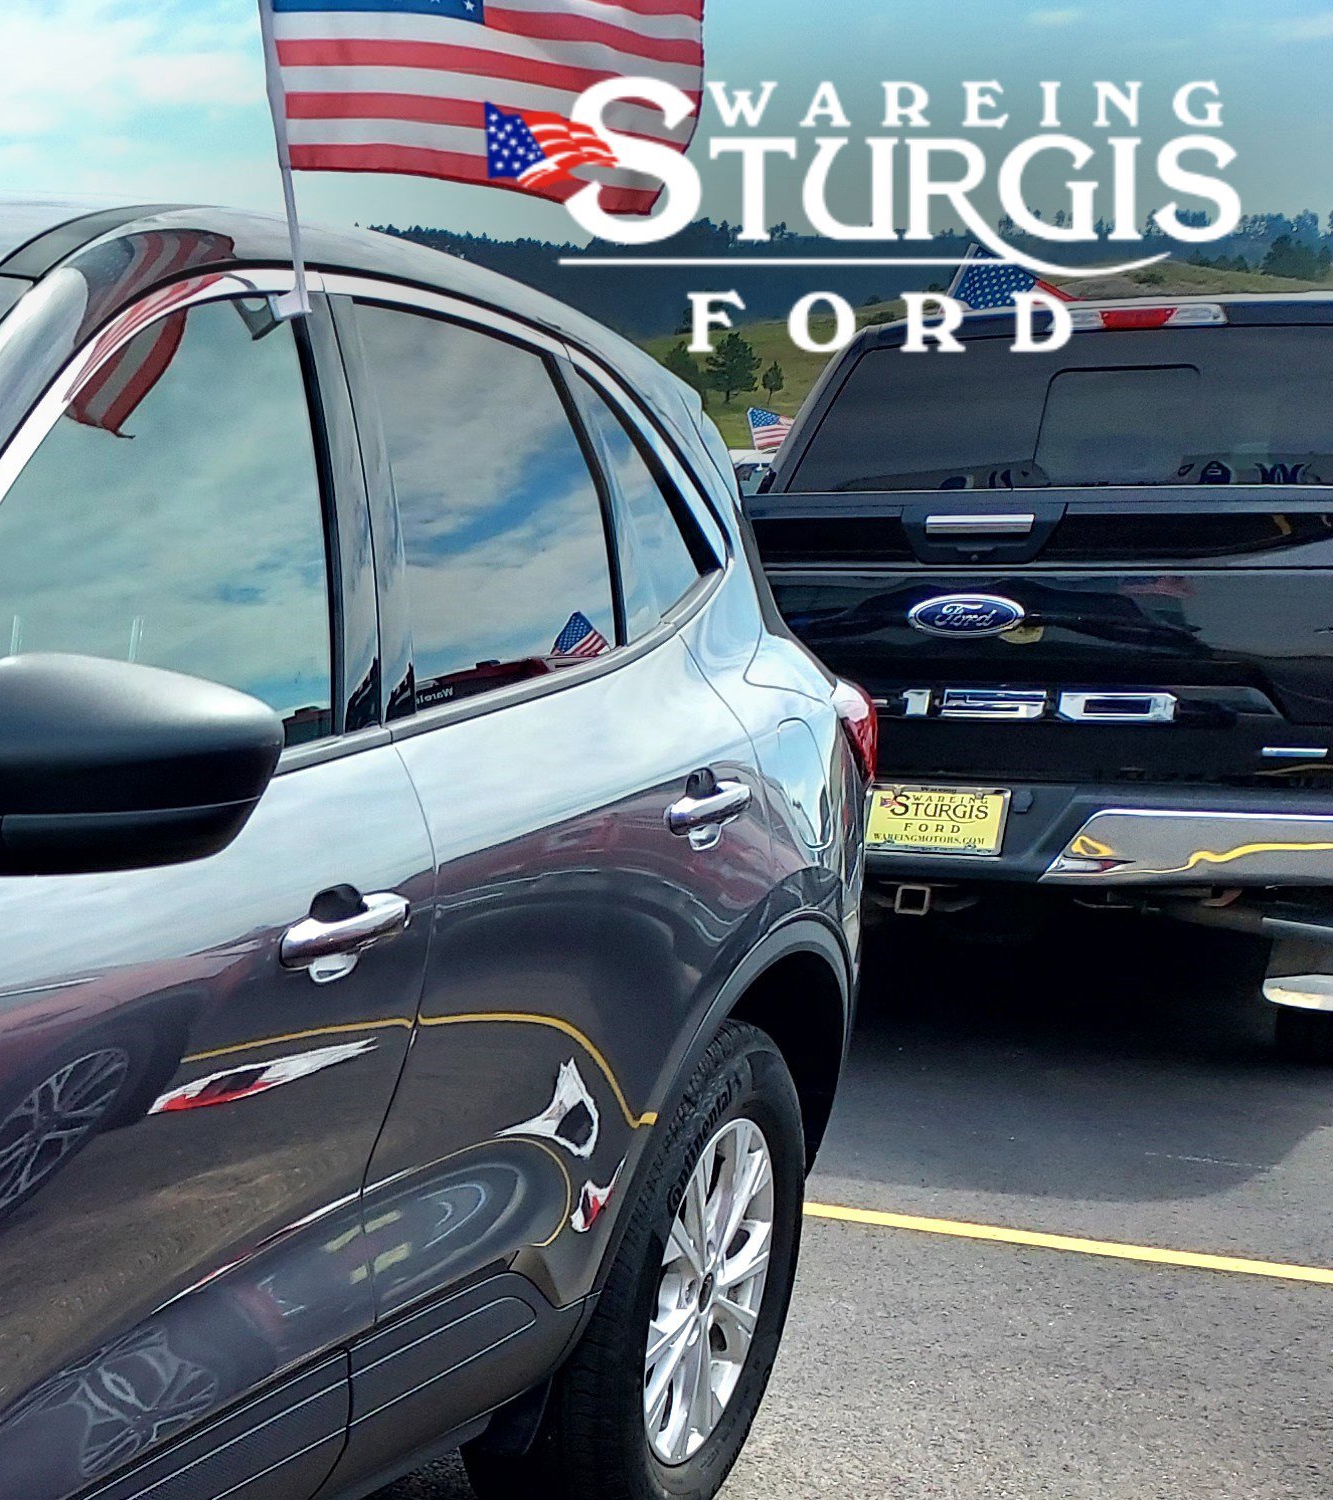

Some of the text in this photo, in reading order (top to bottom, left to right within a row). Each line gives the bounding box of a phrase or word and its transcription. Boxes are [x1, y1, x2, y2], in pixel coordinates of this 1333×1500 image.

[934, 603, 998, 628] Ford
[912, 794, 989, 805] WAREING
[889, 794, 989, 824] STURGIS
[903, 822, 961, 834] FORD
[873, 832, 985, 845] WAREINGMOTORS.COM
